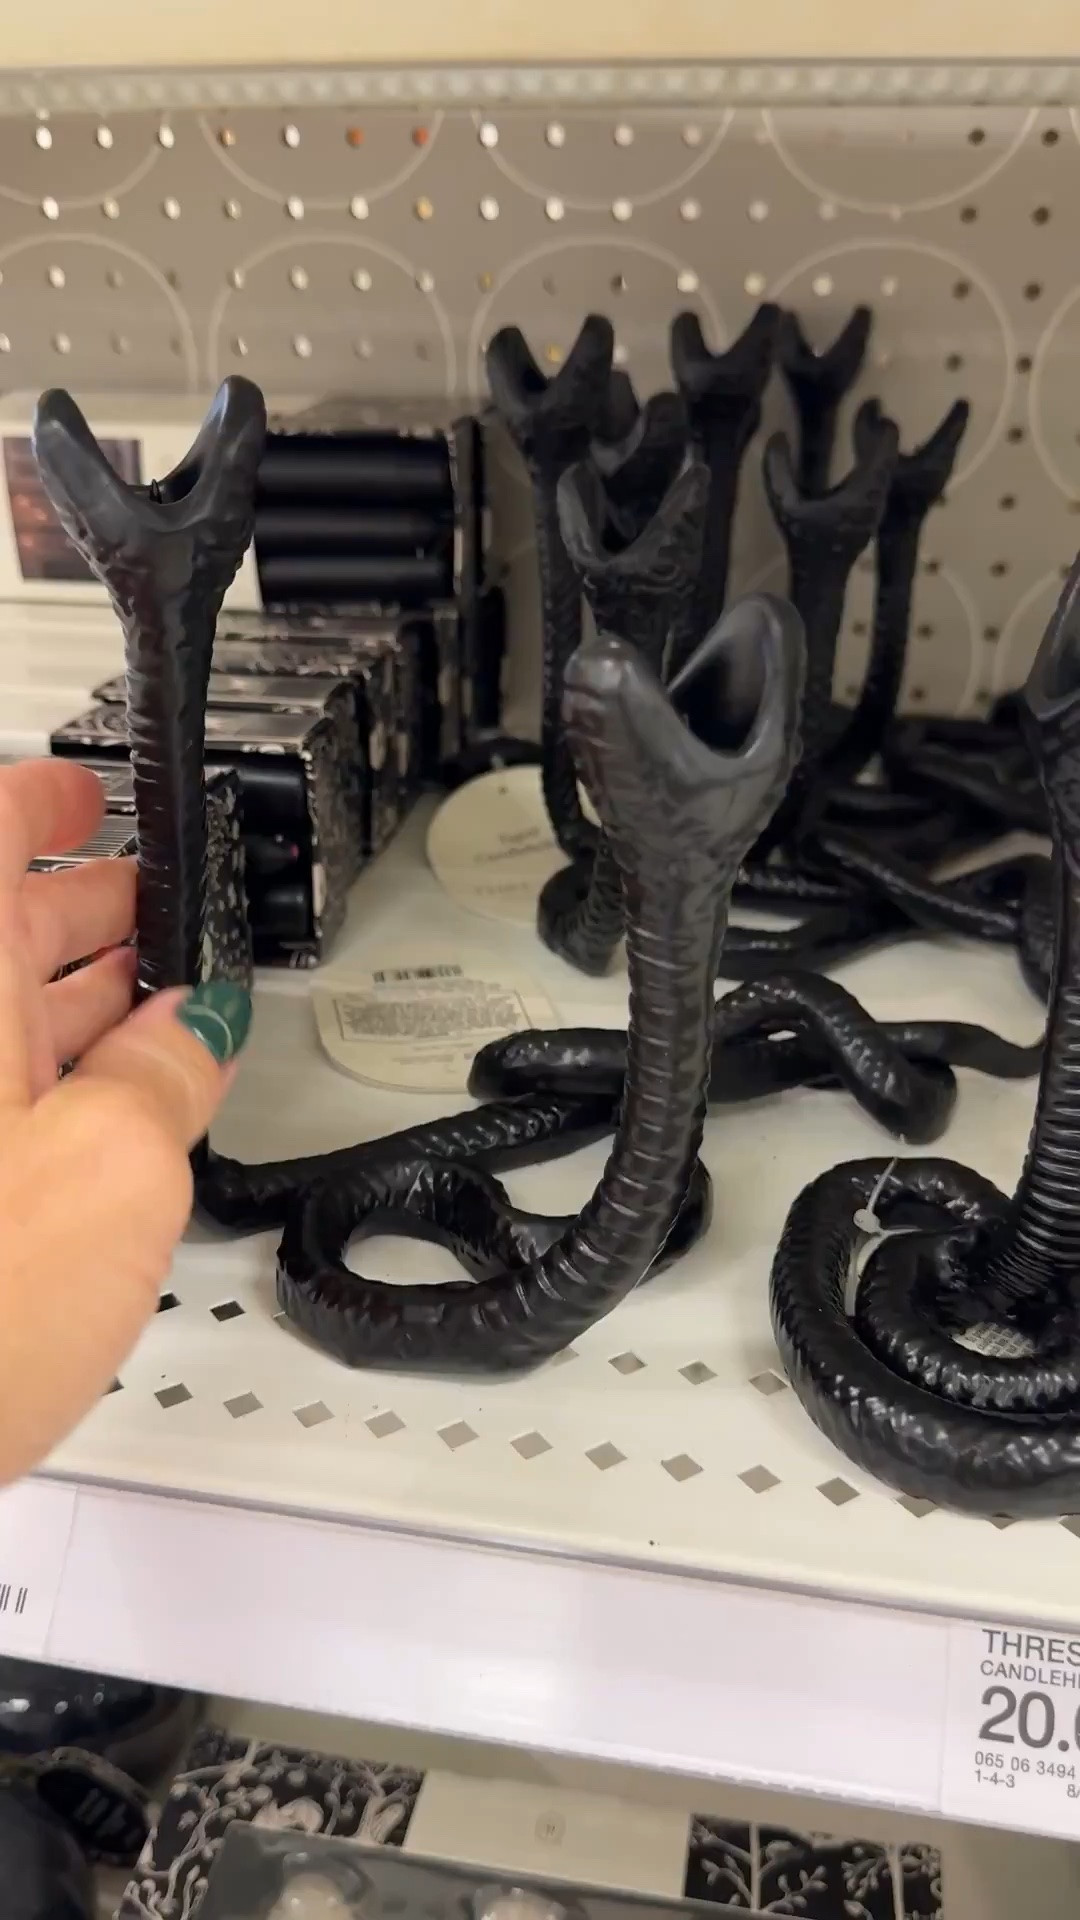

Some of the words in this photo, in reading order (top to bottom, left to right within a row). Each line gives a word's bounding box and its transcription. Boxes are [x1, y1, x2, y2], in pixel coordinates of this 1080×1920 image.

[981, 1628, 1080, 1667] THRES
[980, 1660, 1080, 1688] CANDLEH
[978, 1685, 1080, 1752] 20.
[974, 1751, 1004, 1769] 065
[1010, 1756, 1030, 1772] 06
[1036, 1760, 1076, 1780] 3494
[974, 1769, 1016, 1788] 1-4-3
